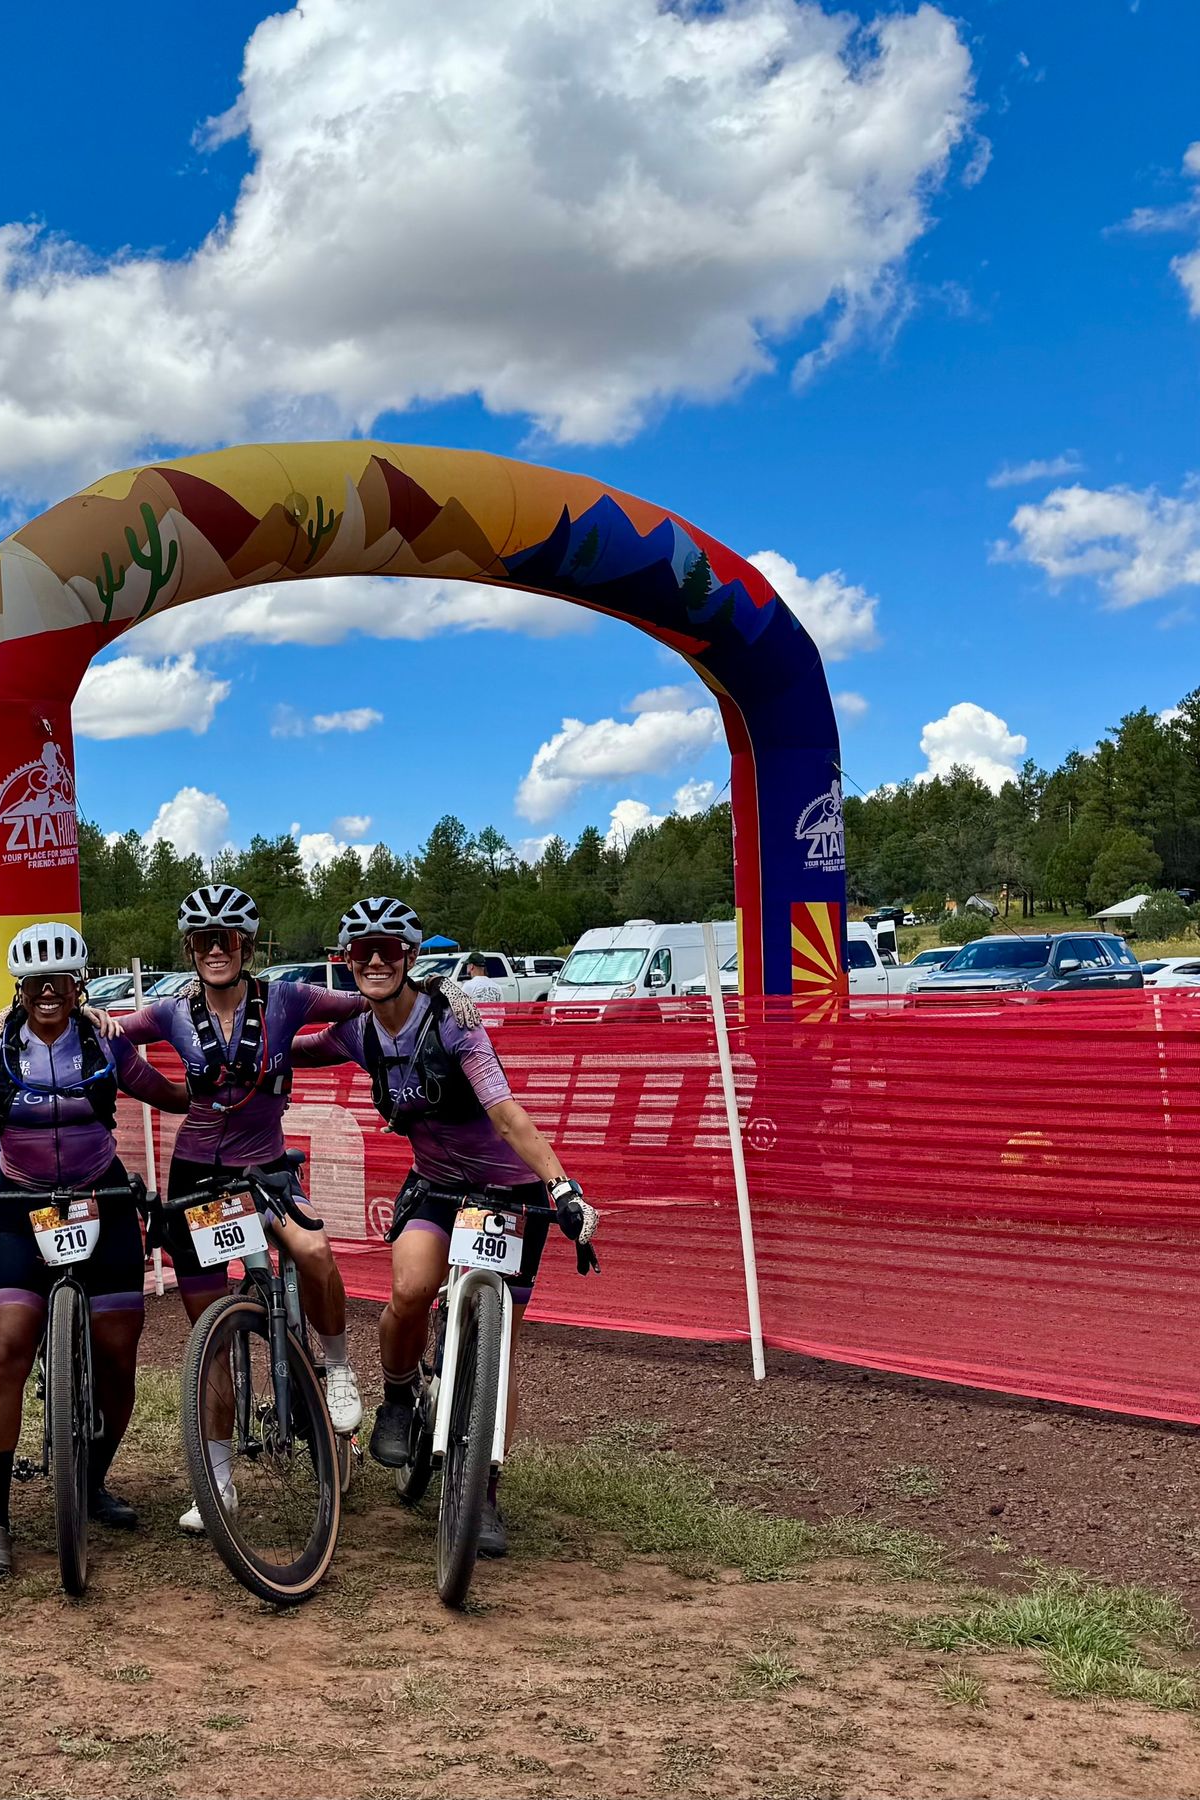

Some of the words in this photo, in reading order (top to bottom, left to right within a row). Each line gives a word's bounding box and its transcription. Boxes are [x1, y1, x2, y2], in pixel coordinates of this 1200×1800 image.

[3, 811, 78, 851] ZIARIDE
[2, 853, 22, 863] YOUR
[23, 850, 47, 861] PLACE
[47, 848, 59, 859] FOR
[54, 1229, 88, 1253] 210
[214, 1225, 245, 1249] 450
[472, 1236, 507, 1260] 490
